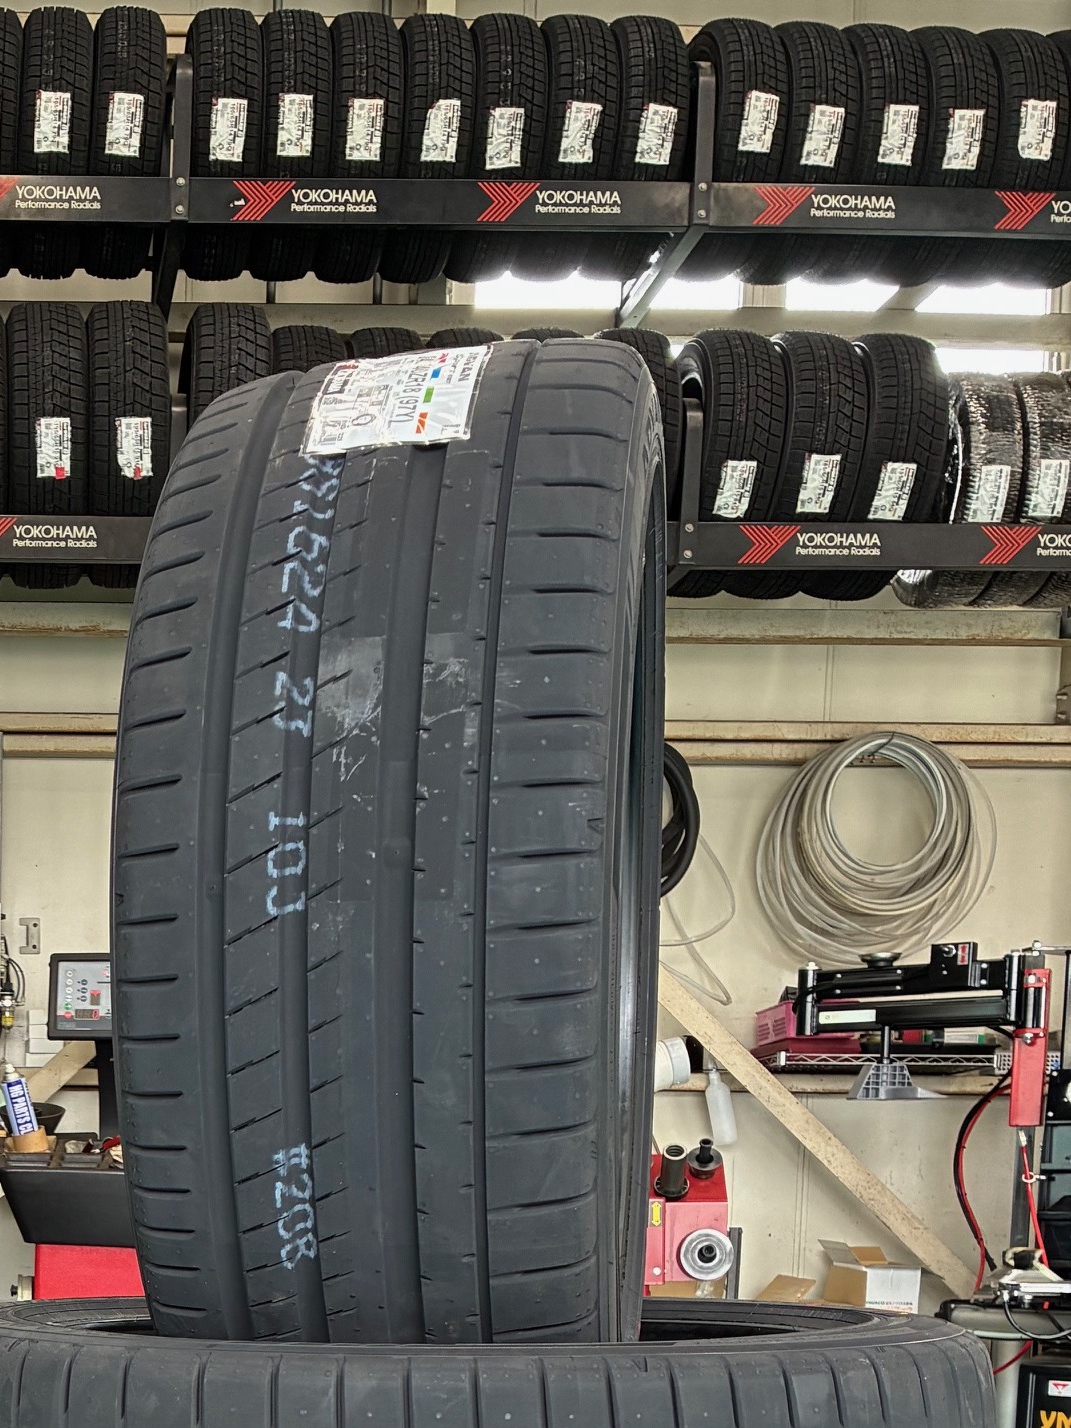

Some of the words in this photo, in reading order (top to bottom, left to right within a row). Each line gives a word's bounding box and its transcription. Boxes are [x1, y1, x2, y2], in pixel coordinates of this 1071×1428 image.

[14, 184, 101, 199] YOKOHAMA
[292, 189, 377, 202] YOKOHAMA
[536, 190, 621, 203] YOKOHAMA
[15, 200, 68, 211] Performance
[71, 200, 101, 211] Radials
[291, 202, 344, 212] Performance
[346, 202, 376, 212] Radials
[811, 194, 895, 208] YOKOHAMA
[536, 203, 589, 213] Performance
[591, 203, 621, 213] Radials
[810, 208, 863, 218] Performance
[865, 208, 895, 218] Radials
[13, 525, 97, 538] YOKOHAMA
[13, 539, 65, 547] Performance
[68, 539, 97, 547] Radials
[797, 533, 881, 546] YOKOHAMA
[796, 547, 848, 555] Performance
[851, 547, 880, 555] Radials
[9, 1084, 22, 1098] HG
[12, 1097, 30, 1123] PARTS
